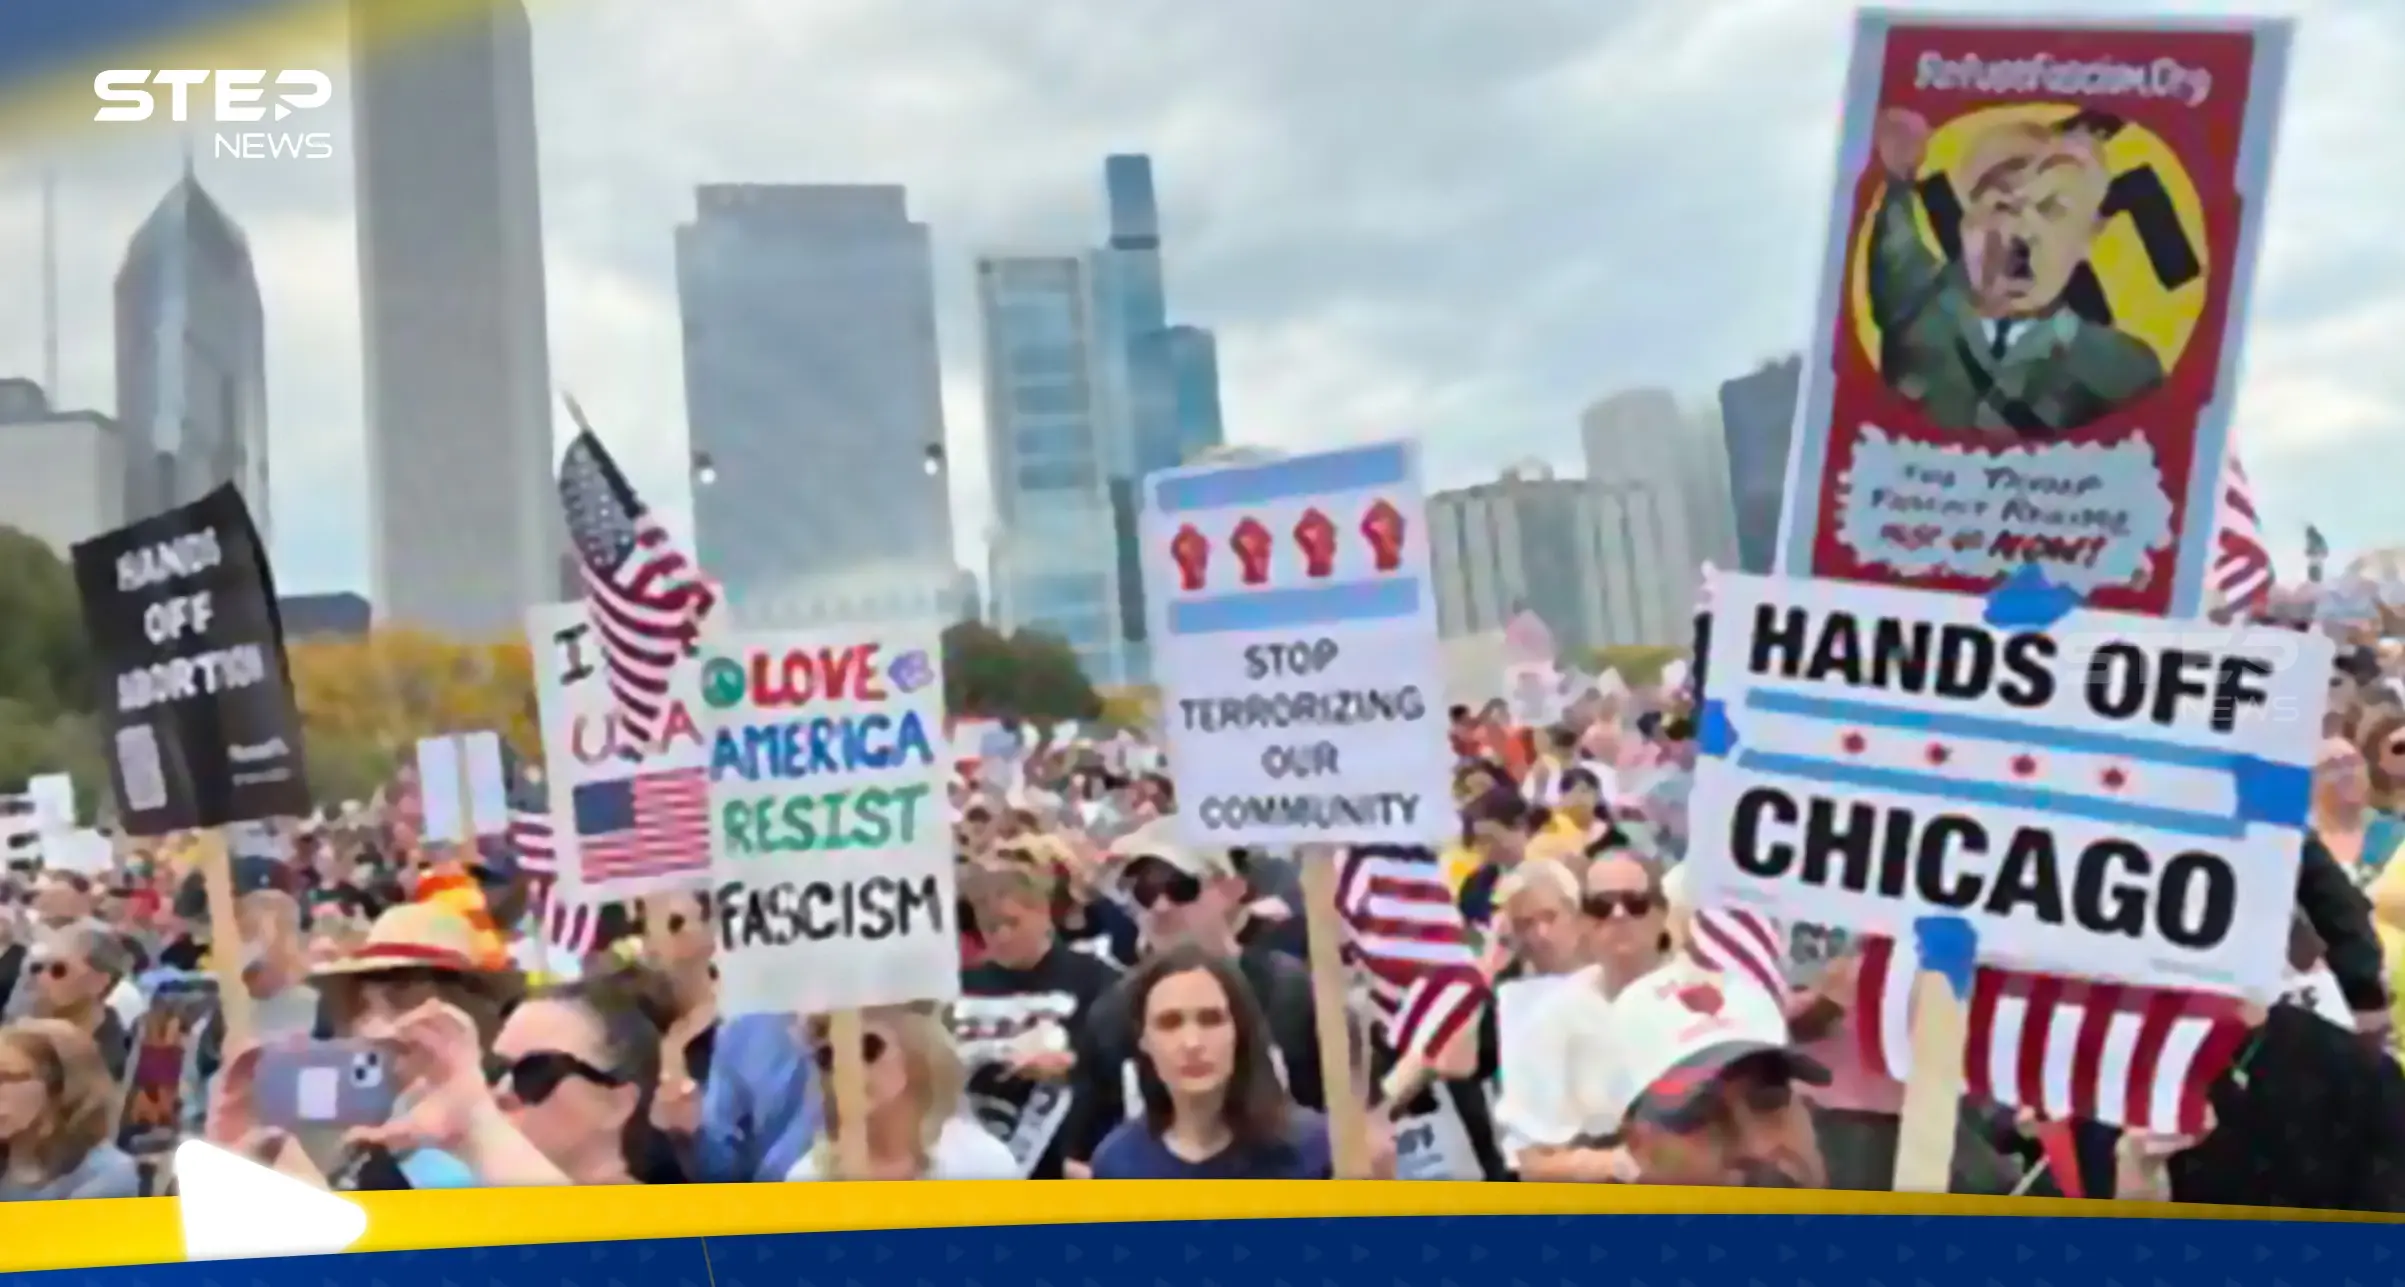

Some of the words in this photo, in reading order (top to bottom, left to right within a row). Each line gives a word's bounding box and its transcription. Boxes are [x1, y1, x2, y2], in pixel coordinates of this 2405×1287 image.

[144, 590, 214, 645] OFF
[748, 643, 888, 709] LOVE
[1244, 637, 1340, 680] STOP
[1747, 603, 2058, 709] HANDS
[2084, 640, 2275, 734] OFF
[1179, 685, 1425, 733] TERRORIZING
[709, 710, 934, 781] AMERICA
[1260, 740, 1340, 779] OUR
[722, 782, 930, 856] RESIST
[1199, 793, 1420, 831] COMMUNITY
[1729, 785, 2237, 951] CHICAGO
[716, 875, 944, 952] FASCISM
